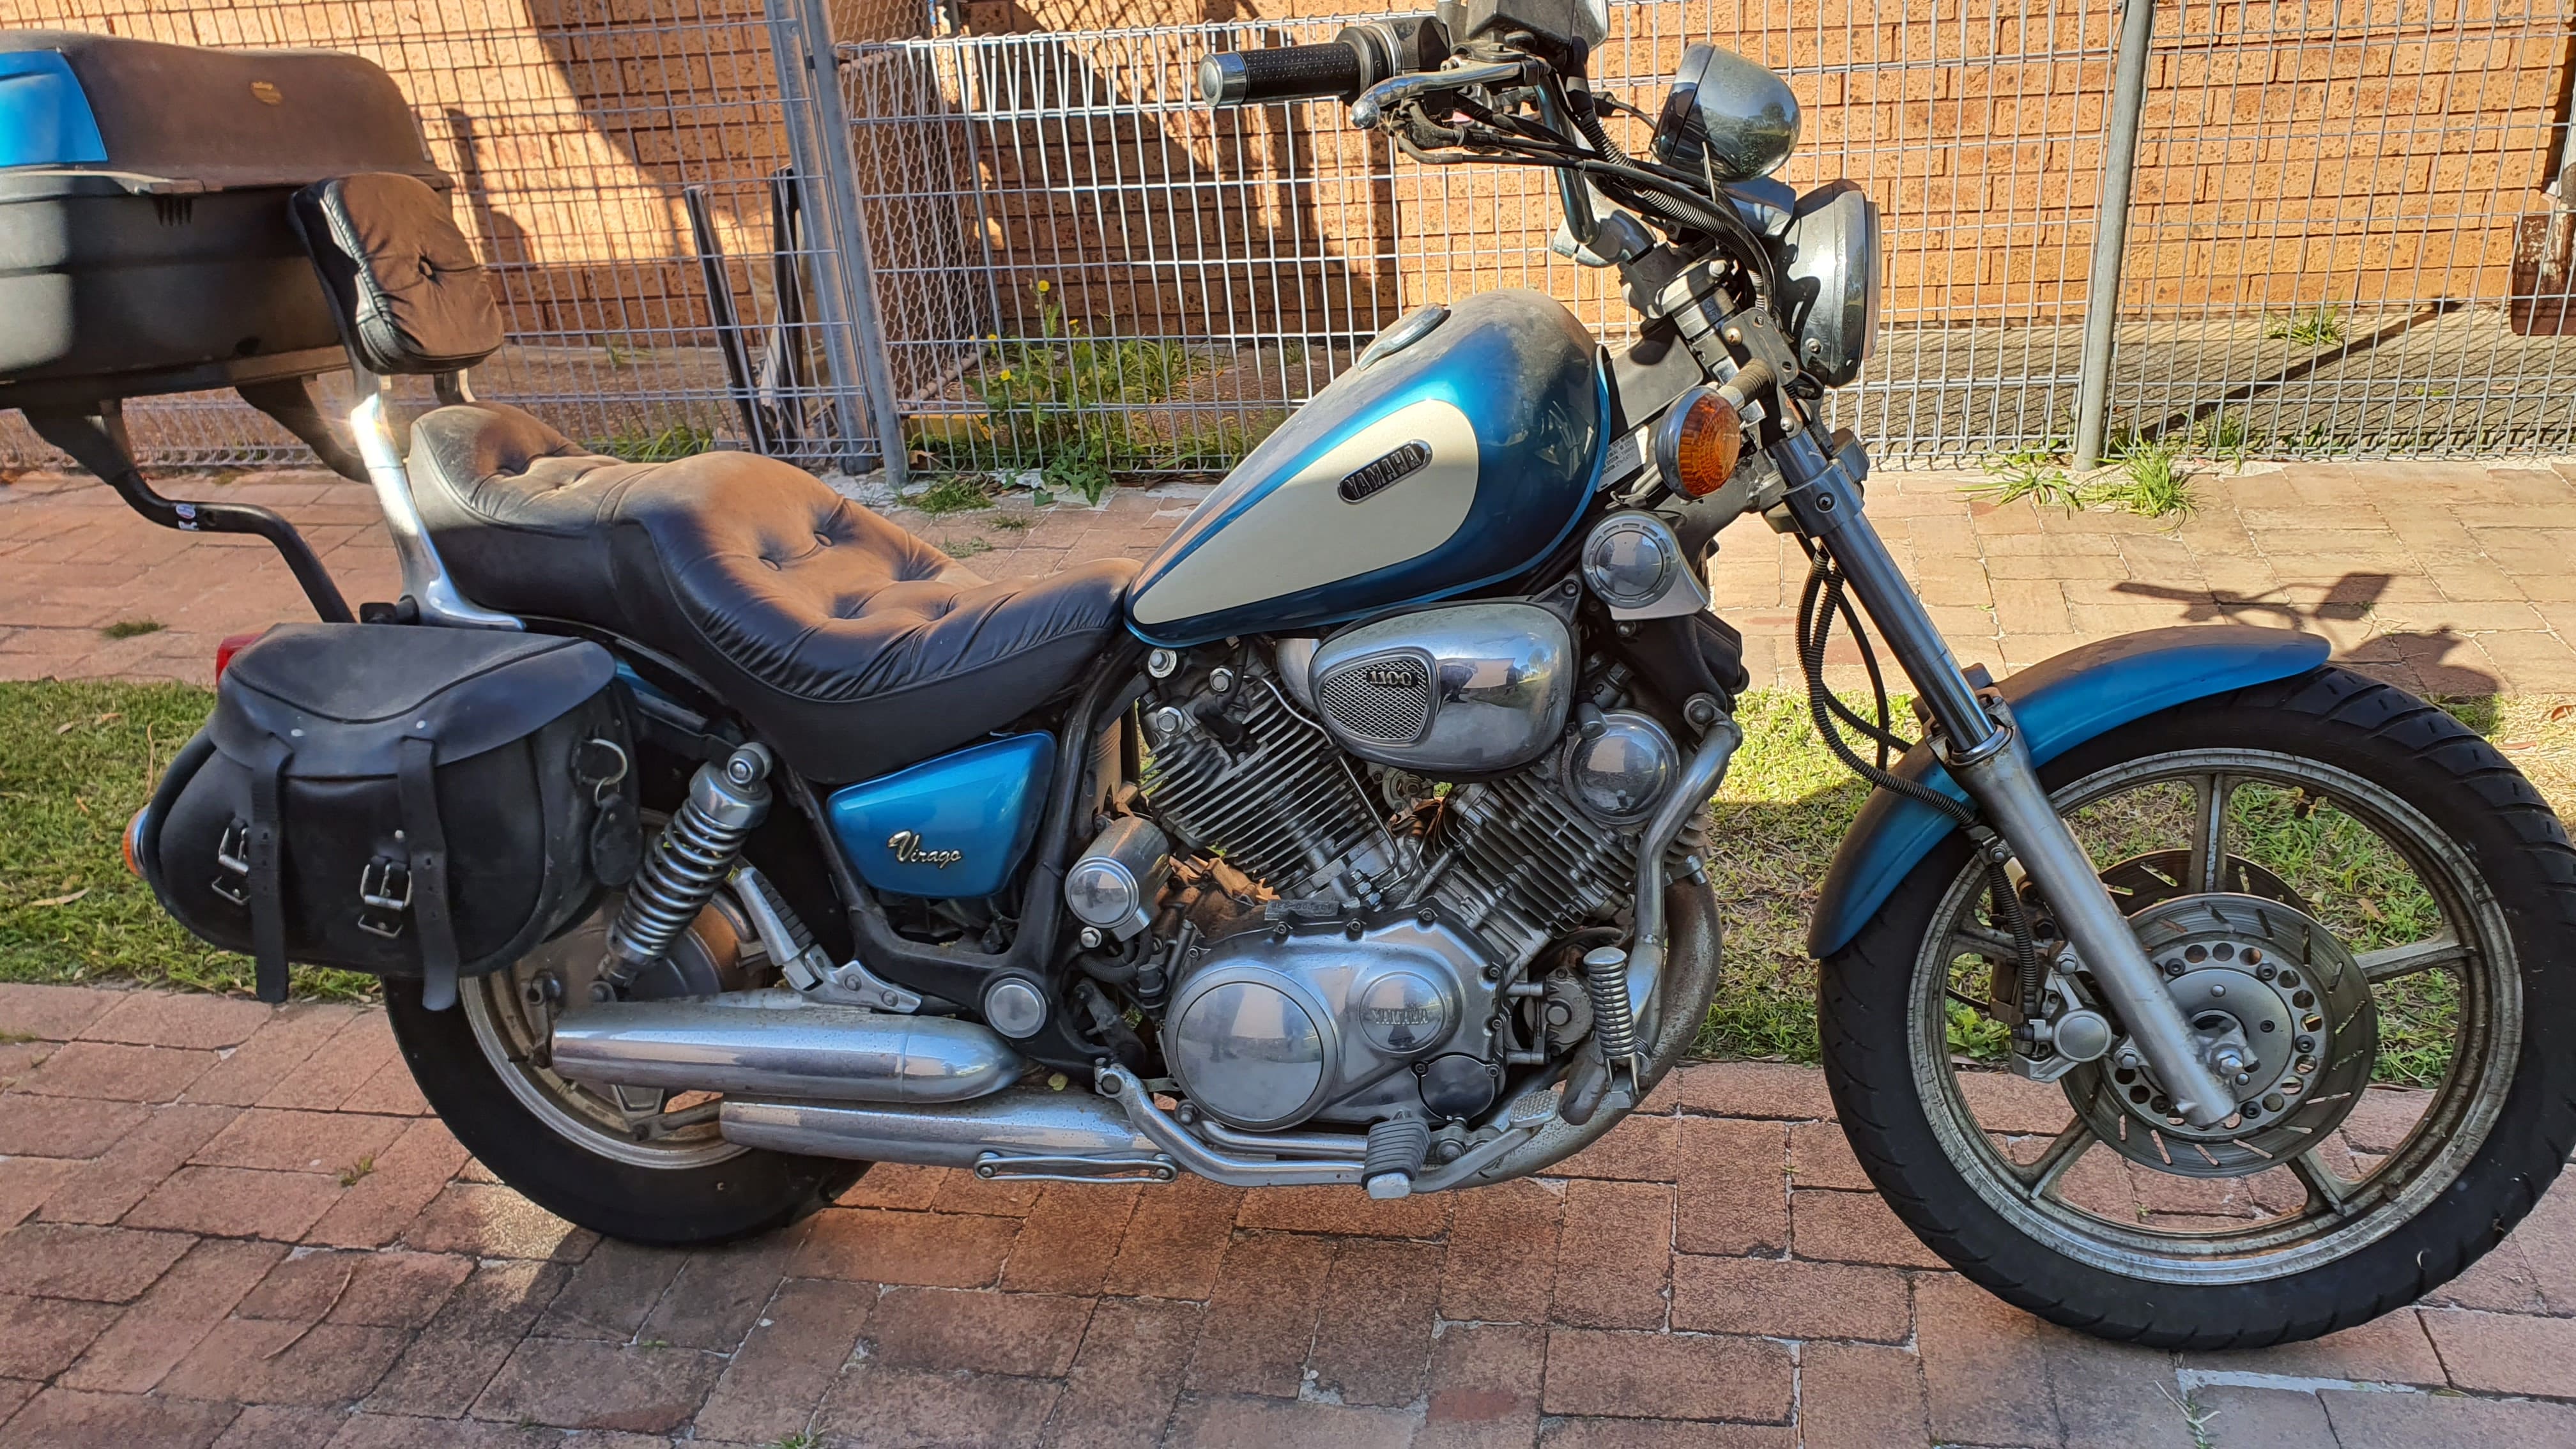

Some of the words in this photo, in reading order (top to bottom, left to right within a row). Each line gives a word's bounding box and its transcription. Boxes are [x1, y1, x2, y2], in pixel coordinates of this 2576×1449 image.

[1345, 445, 1422, 498] YAMAHA
[1368, 670, 1413, 686] 1100
[887, 830, 962, 869] Virago
[1373, 1008, 1429, 1025] YAMAHA
